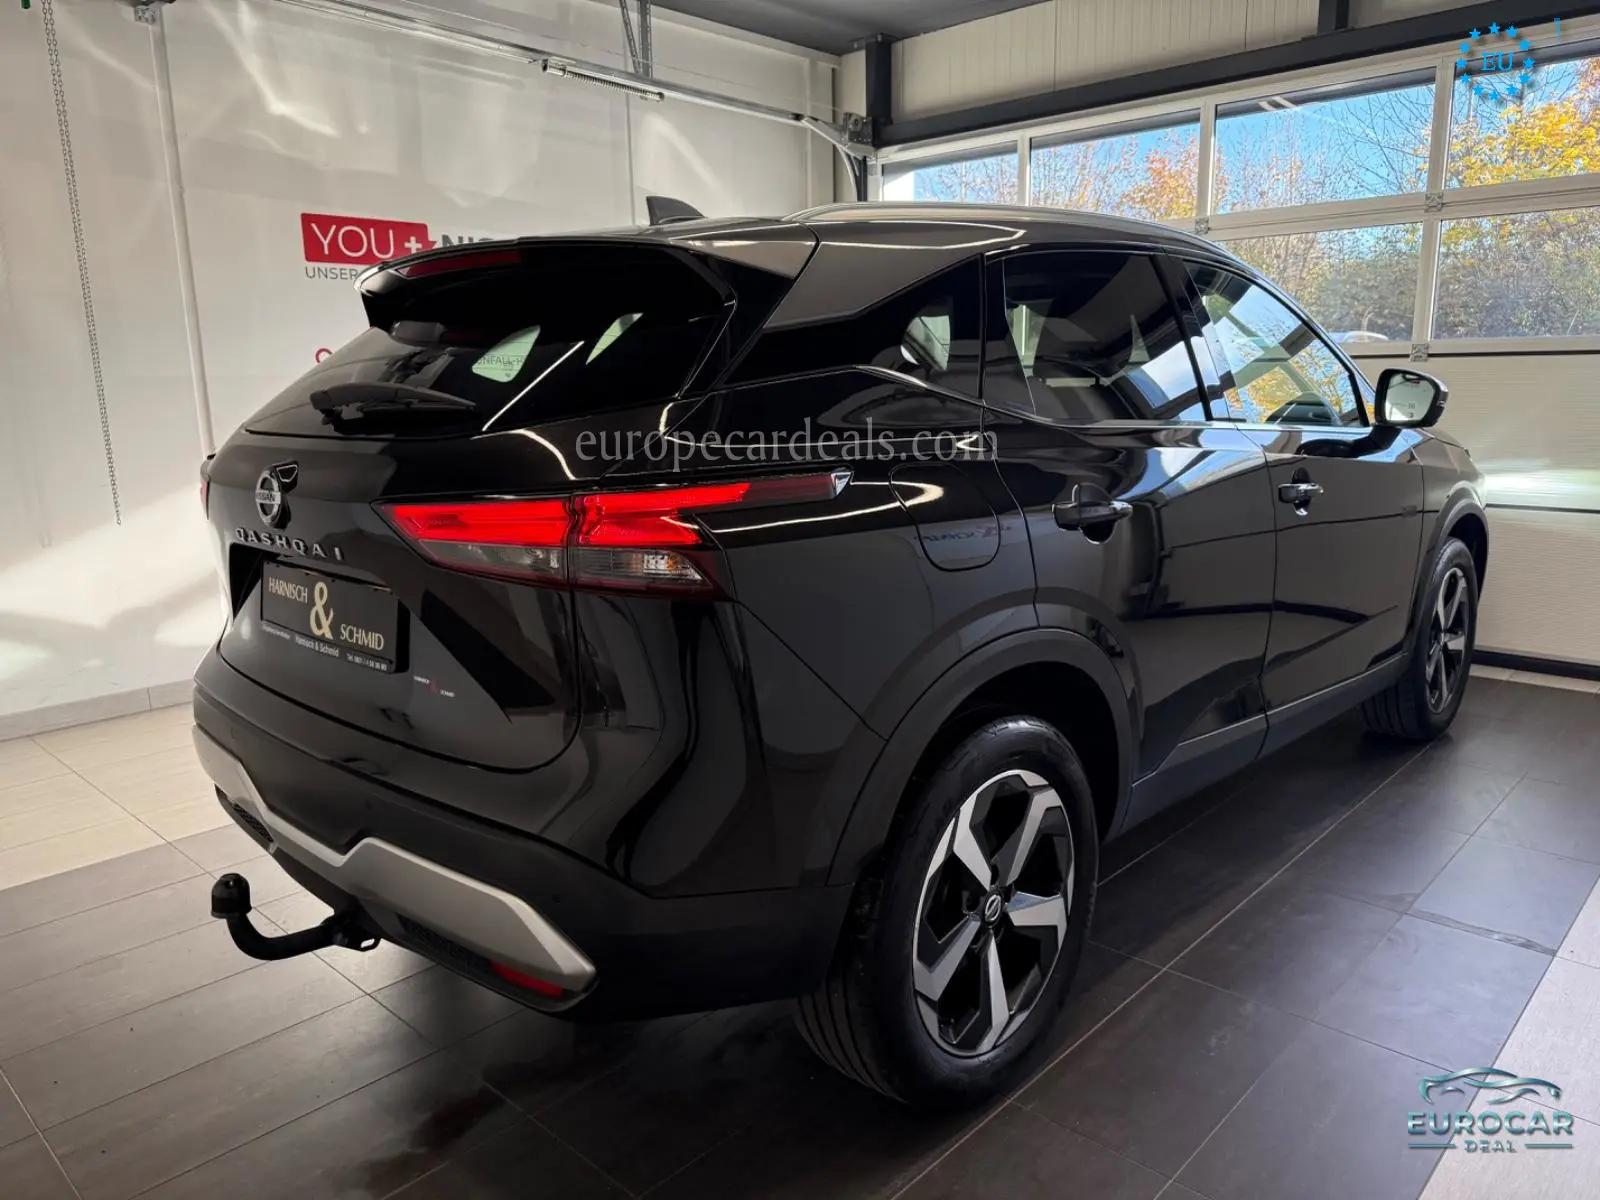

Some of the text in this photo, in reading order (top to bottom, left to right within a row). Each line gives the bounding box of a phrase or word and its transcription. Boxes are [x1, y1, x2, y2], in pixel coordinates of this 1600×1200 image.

[310, 222, 395, 260] YOU
[305, 265, 359, 281] UNSER
[235, 527, 342, 561] QASHQAI
[268, 576, 308, 604] HARNISCH
[309, 581, 334, 640] &
[340, 622, 385, 652] SCHMID
